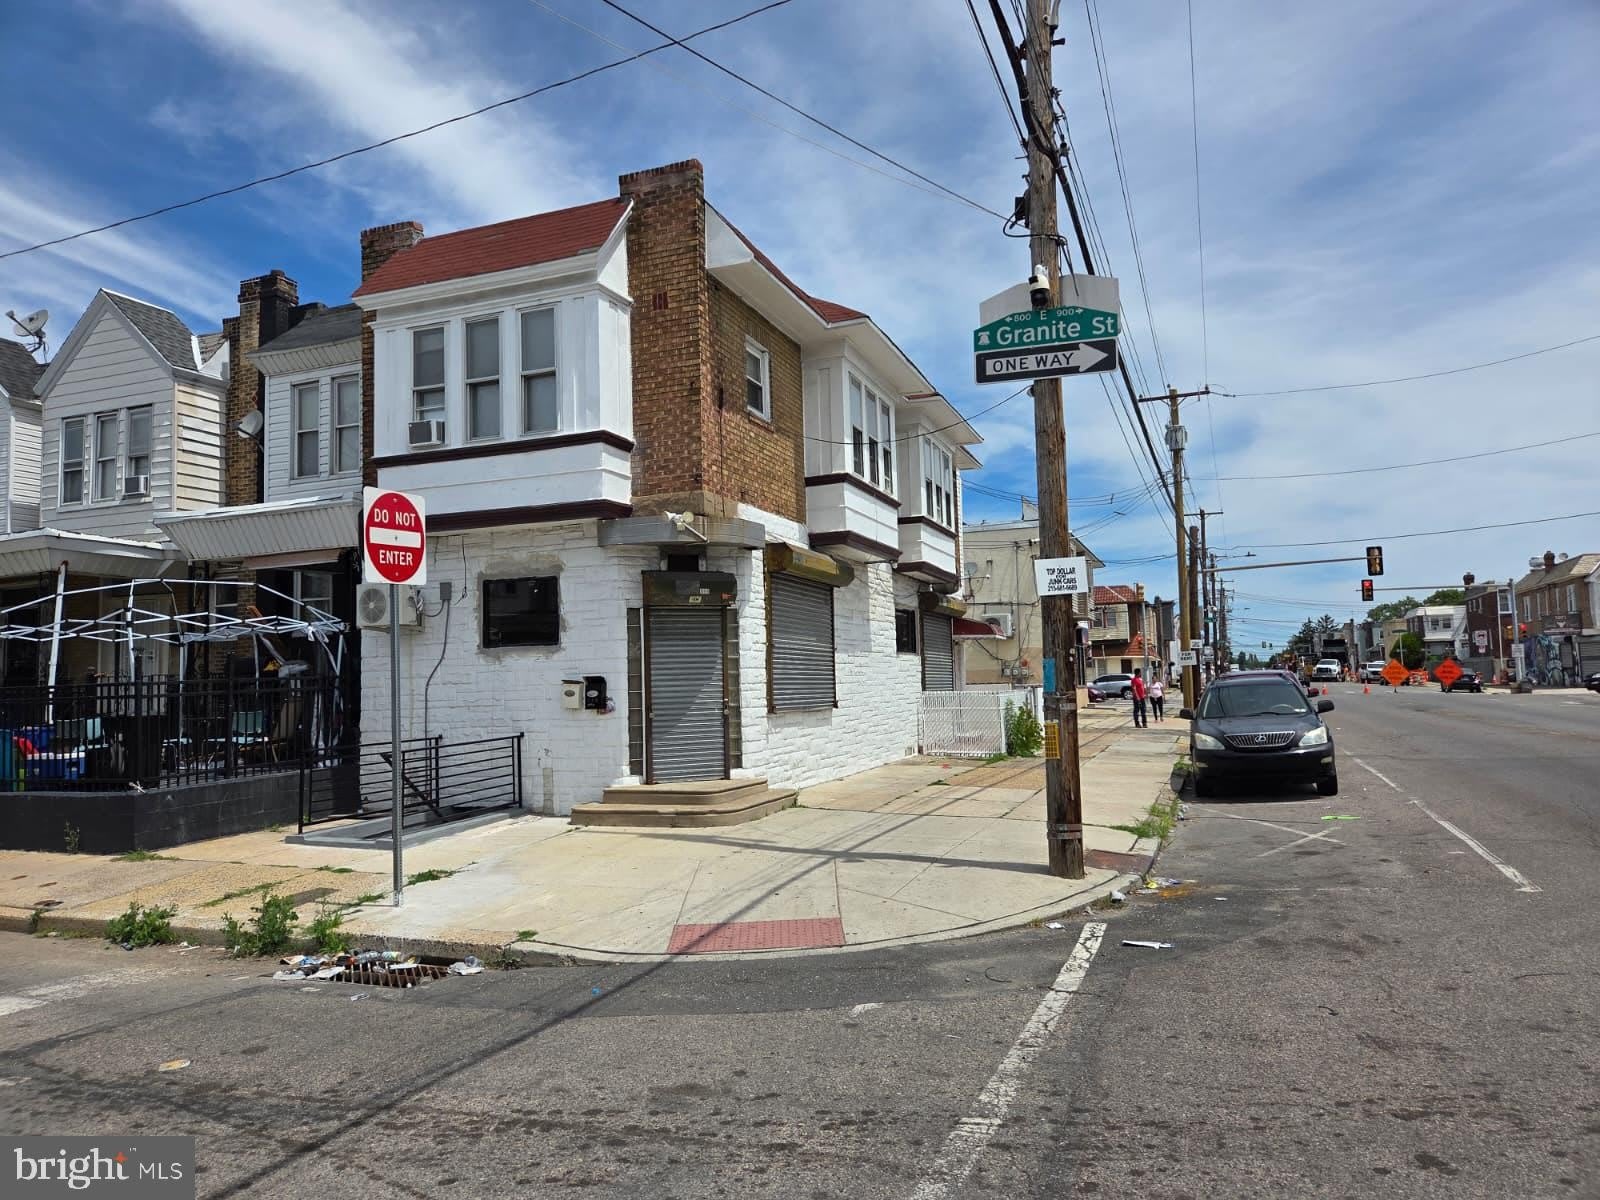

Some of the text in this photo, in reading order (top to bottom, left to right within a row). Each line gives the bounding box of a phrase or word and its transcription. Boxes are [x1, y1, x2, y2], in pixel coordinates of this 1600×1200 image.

[1014, 308, 1074, 321] 800 E 900
[996, 316, 1114, 345] Granite St
[992, 352, 1075, 373] ONE WAY
[374, 508, 416, 527] DO NOT
[379, 549, 413, 567] ENTER
[1056, 567, 1076, 575] DOLLAR
[1063, 577, 1077, 585] CARS
